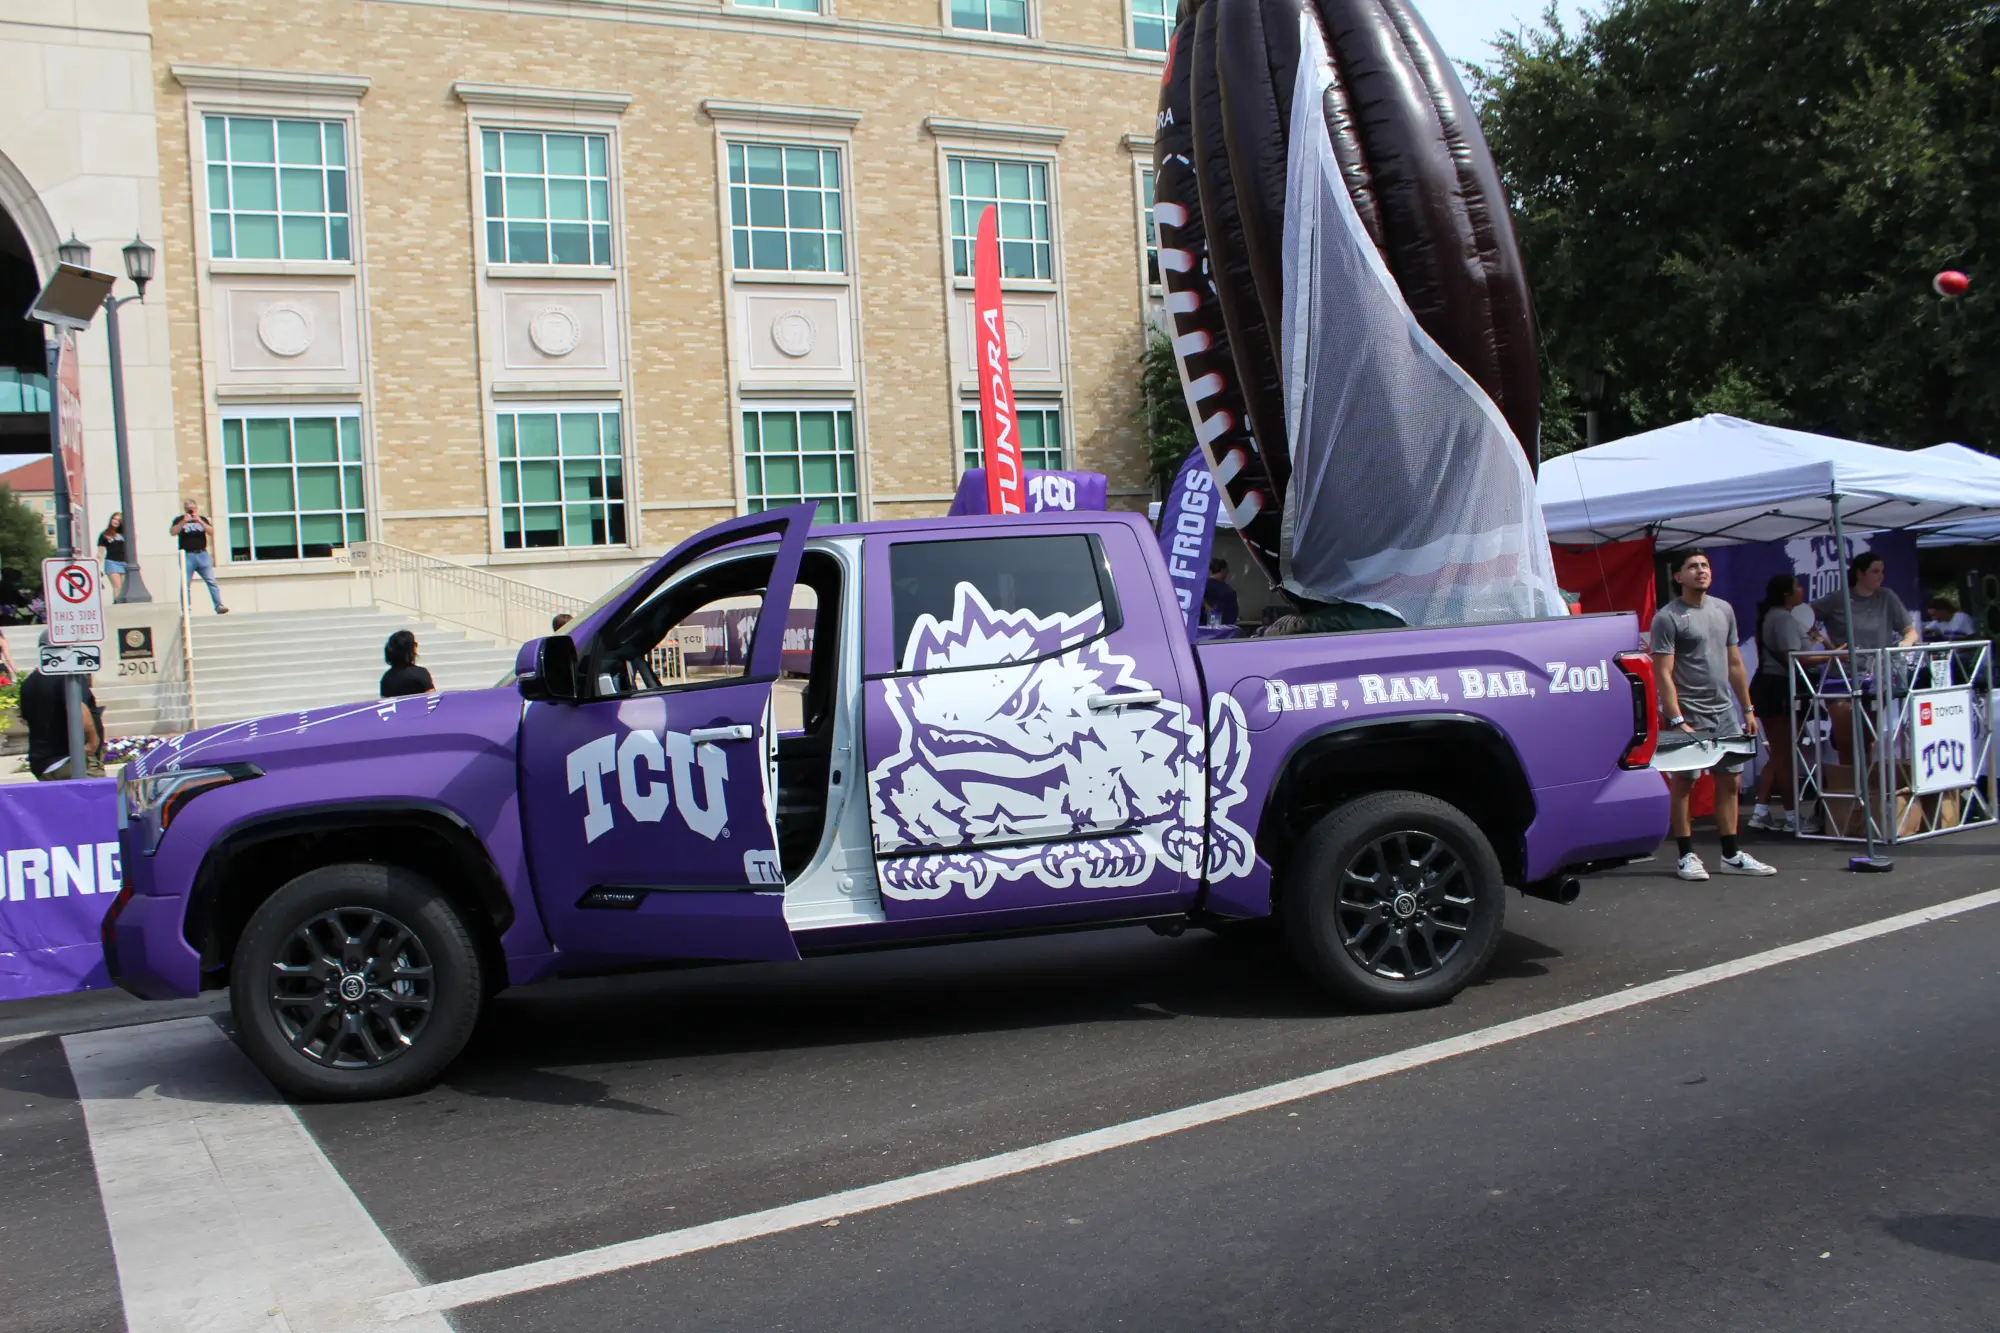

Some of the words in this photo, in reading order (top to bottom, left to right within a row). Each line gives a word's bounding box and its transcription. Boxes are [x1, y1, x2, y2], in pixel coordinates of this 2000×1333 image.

[983, 308, 1020, 514] TUNDRA
[1029, 475, 1076, 513] TCU
[1169, 469, 1213, 579] FROGS
[54, 611, 74, 621] THIS
[80, 610, 97, 620] SIDE
[55, 625, 65, 636] OF
[71, 624, 99, 635] STREET
[117, 661, 158, 676] 2901
[1935, 705, 1963, 718] TOYOTA
[1922, 739, 1965, 781] TCU
[566, 730, 729, 844] TCU
[0, 842, 121, 901] RNE
